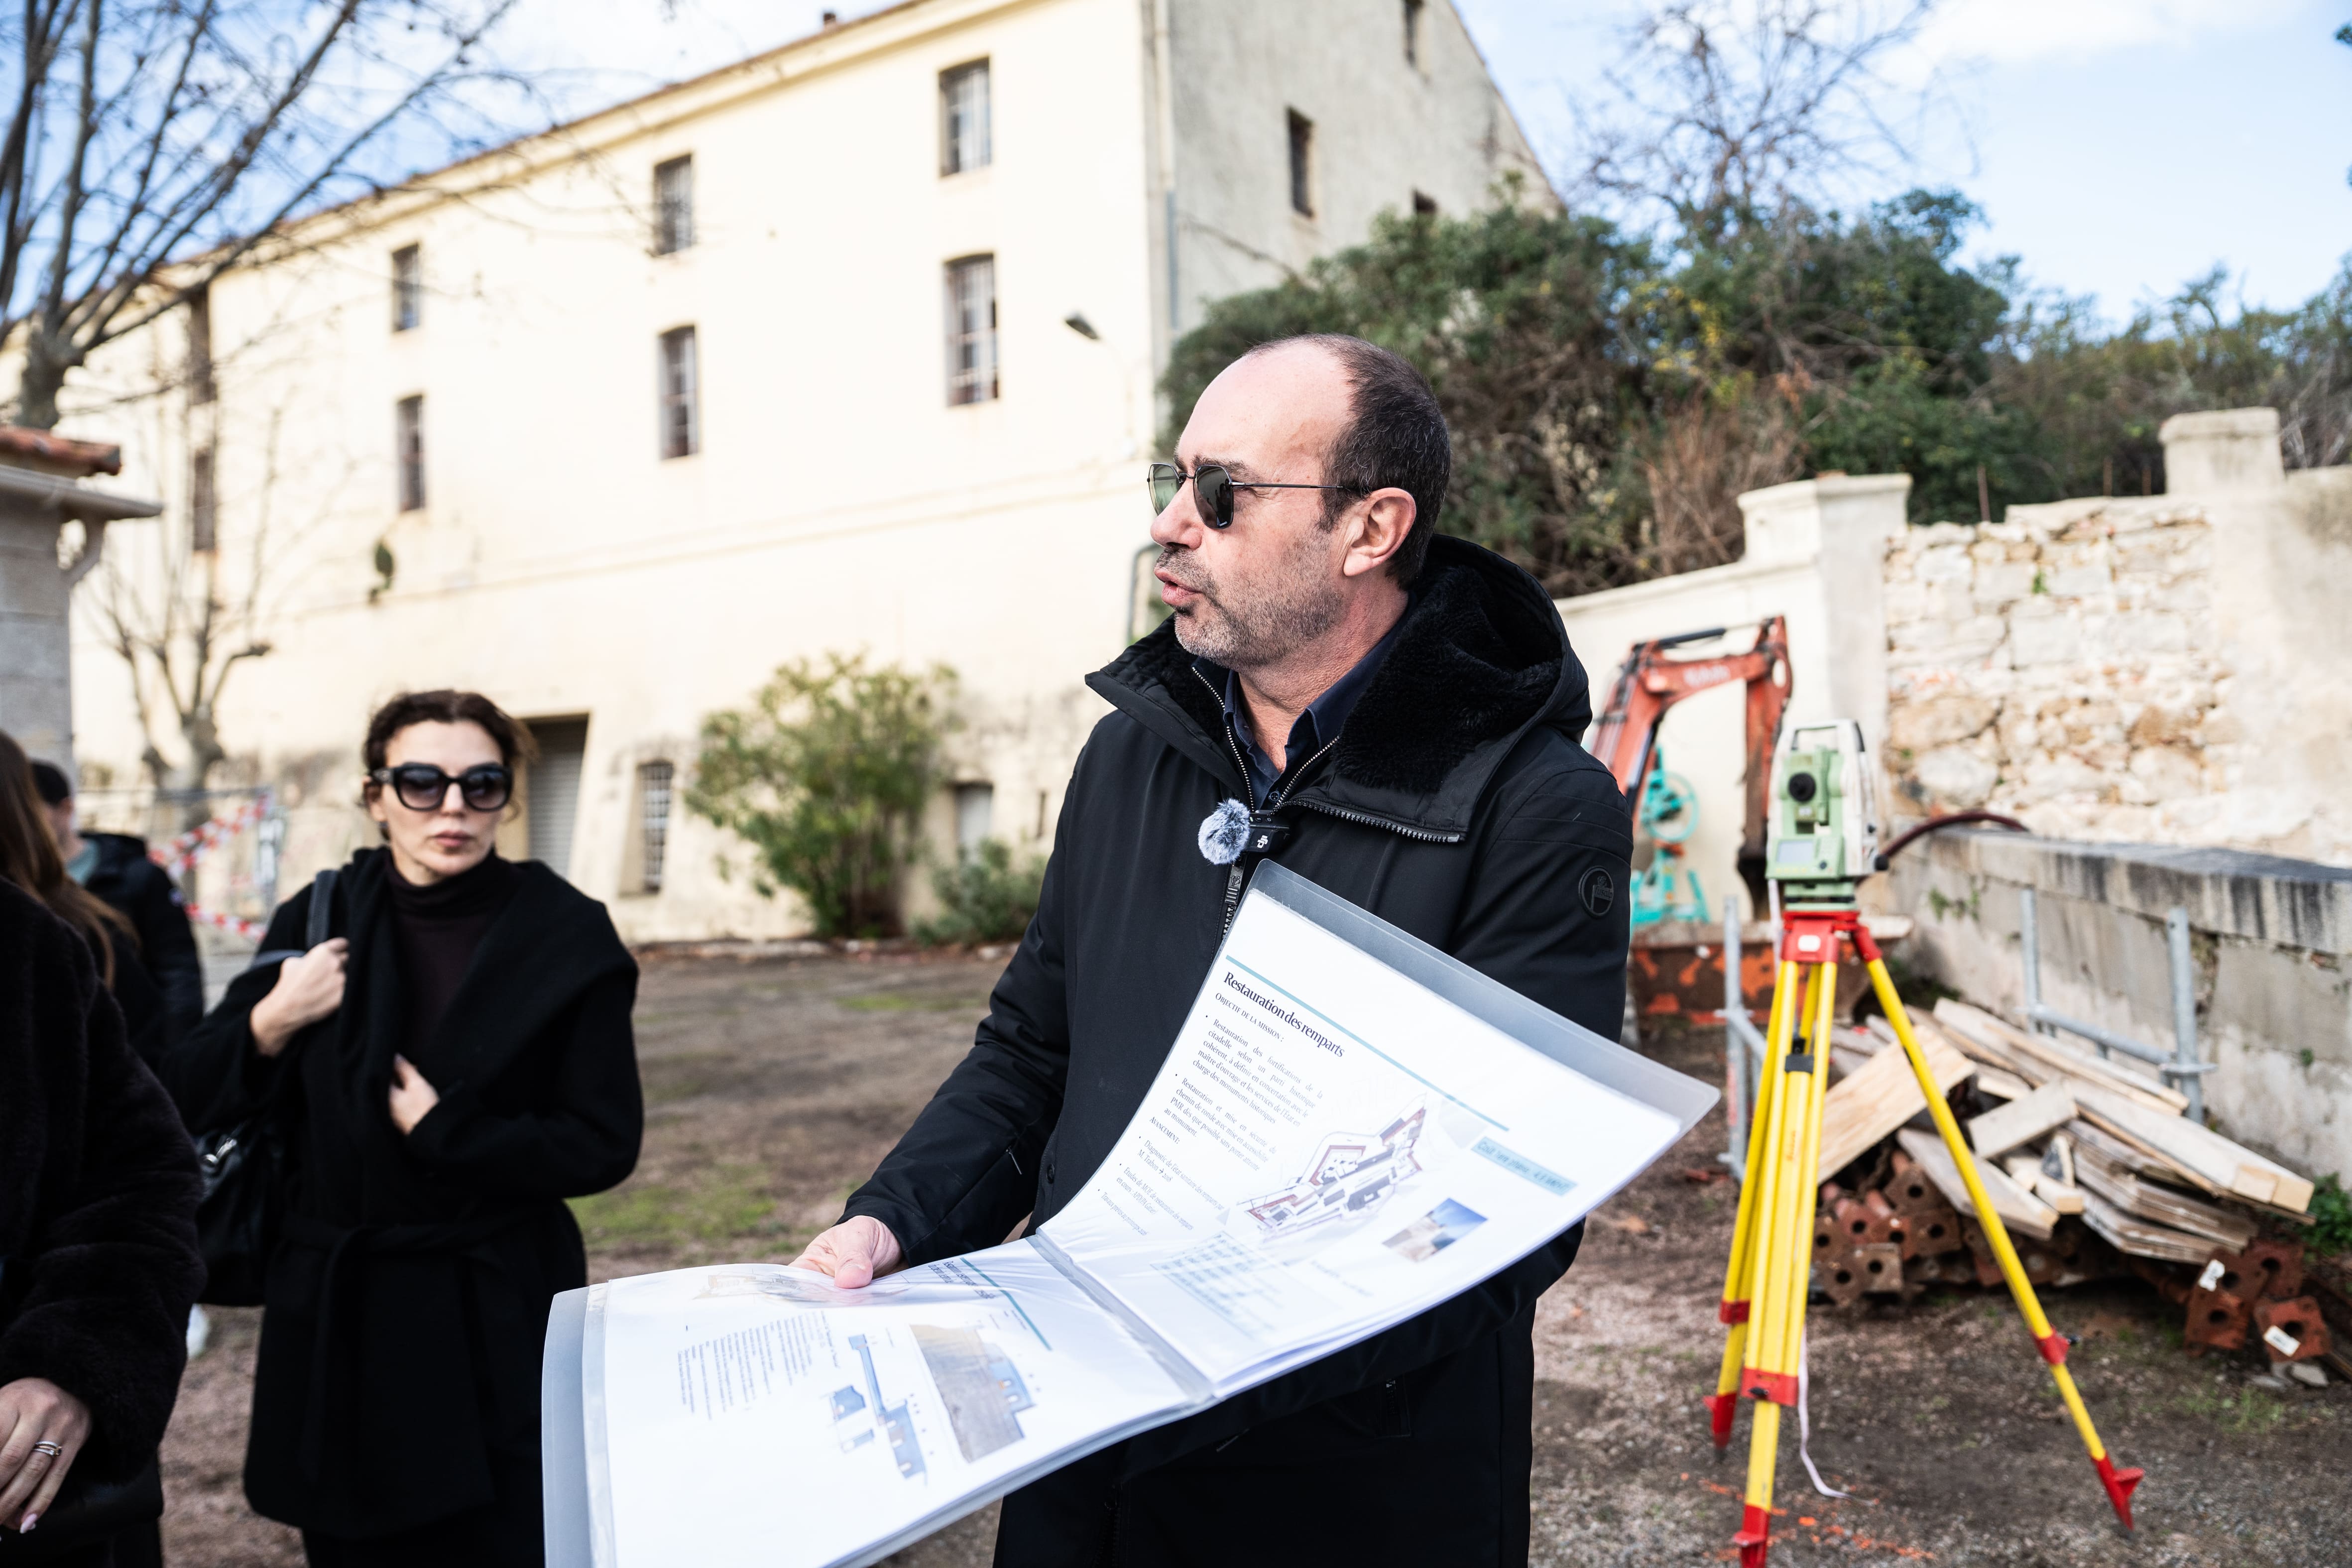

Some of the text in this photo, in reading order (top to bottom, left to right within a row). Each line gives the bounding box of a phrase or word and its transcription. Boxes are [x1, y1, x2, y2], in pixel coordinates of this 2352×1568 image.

[1223, 971, 1345, 1057] Restauration des remparts
[1241, 1010, 1250, 1019] DE
[1249, 1016, 1257, 1024] LA
[1257, 1021, 1280, 1040] MISSION
[1197, 1050, 1216, 1066] maître
[1246, 1083, 1255, 1093] les
[1254, 1091, 1274, 1108] services
[1273, 1104, 1281, 1113] de
[1208, 1030, 1316, 1109] citadelle selon un parti historique
[1213, 1018, 1323, 1099] Restauration des fortifications de la
[1181, 1078, 1213, 1105] Restauration
[1224, 1112, 1237, 1124] mise
[1192, 1060, 1275, 1124] charge des monuments historiques
[1233, 1061, 1251, 1077] définir
[1259, 1081, 1291, 1106] concertation
[1291, 1103, 1303, 1114] avec
[1170, 1096, 1184, 1111] PMR
[1183, 1107, 1192, 1118] dès
[1191, 1115, 1202, 1126] que
[1200, 1123, 1221, 1141] possible
[1219, 1138, 1231, 1149] sans
[1228, 1146, 1245, 1159] porter
[1171, 1113, 1197, 1137] monument.
[1176, 1088, 1195, 1106] chemin
[1194, 1102, 1202, 1111] de
[1201, 1108, 1216, 1122] ronde
[1215, 1119, 1227, 1130] avec
[1225, 1128, 1238, 1140] mise
[1144, 1140, 1168, 1163] Diagnostic
[1165, 1159, 1173, 1168] de
[1121, 1182, 1133, 1195] cours
[1140, 1183, 1154, 1196] MOE
